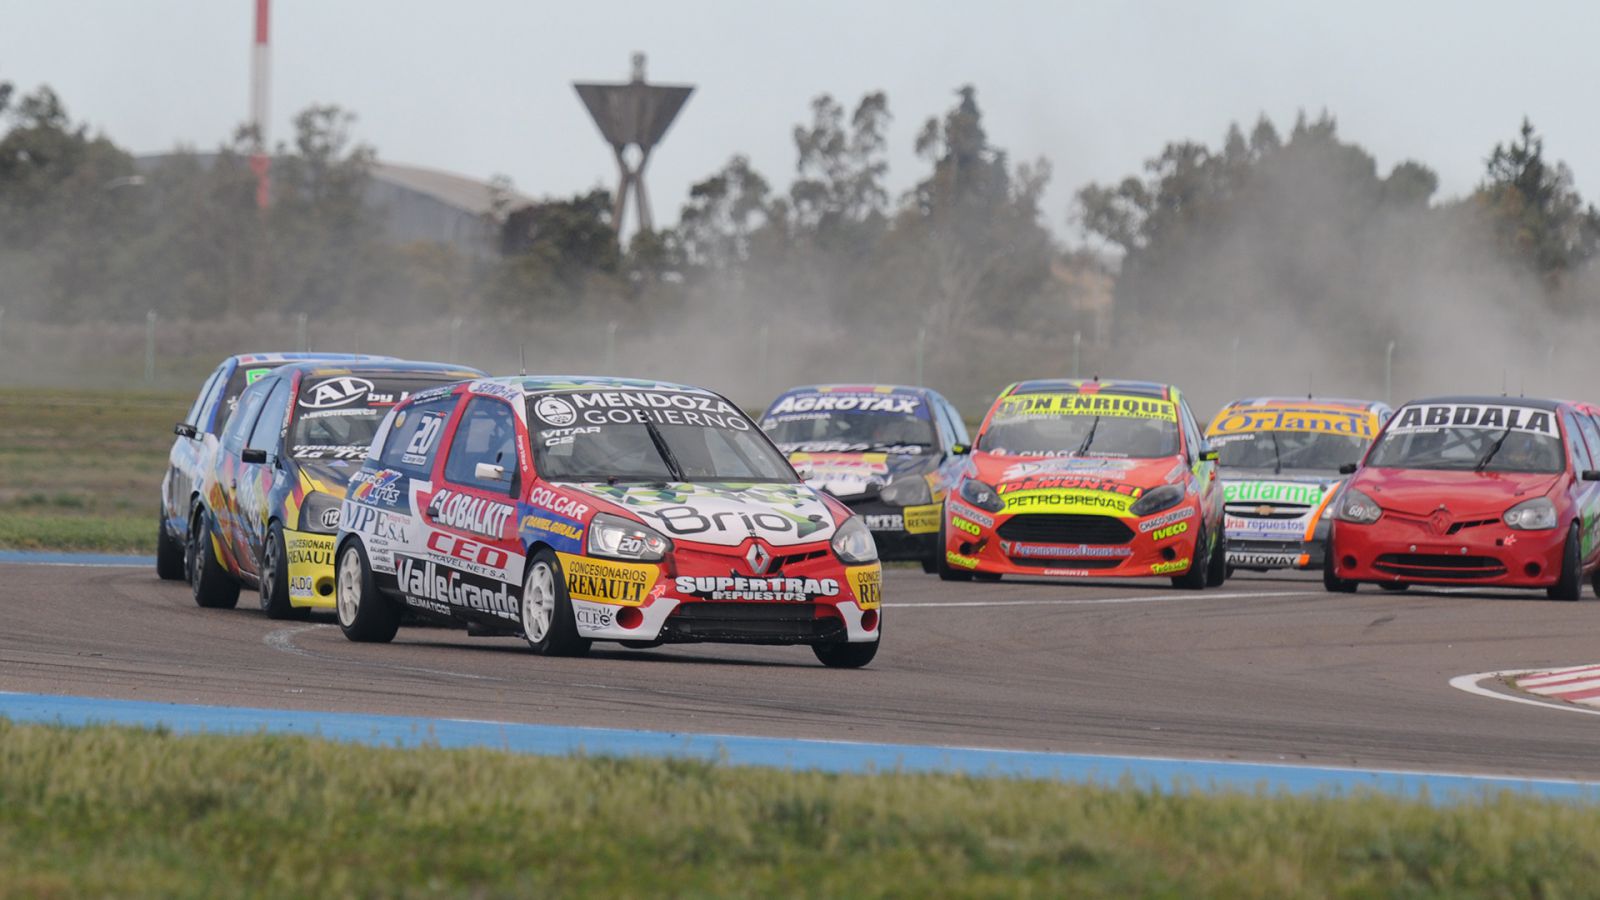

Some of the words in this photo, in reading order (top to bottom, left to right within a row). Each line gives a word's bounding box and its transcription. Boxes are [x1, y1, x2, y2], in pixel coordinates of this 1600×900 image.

[313, 378, 368, 405] AL
[367, 392, 394, 404] by
[572, 393, 741, 416] MENDOZA
[771, 397, 920, 414] AGROTAX
[1060, 398, 1175, 415] ENRIQUE
[584, 409, 750, 431] GOBIERNO
[1217, 413, 1372, 436] Orlandi
[1400, 407, 1550, 433] ABDALA
[406, 416, 442, 455] 20
[541, 426, 601, 439] VITAR
[545, 435, 575, 447] C2
[1006, 478, 1134, 496] DEMONTE
[430, 489, 514, 538] GLOBALKIT
[531, 487, 589, 520] COLCAR
[1008, 495, 1061, 509] PETRO
[1064, 496, 1127, 512] BRENAS
[324, 511, 340, 525] 112
[655, 505, 793, 535] Brio
[865, 514, 904, 529] MTR
[952, 516, 980, 536] IVECO
[1247, 518, 1305, 531] repuestos
[1153, 522, 1187, 540] IVECO
[427, 531, 509, 570] CEO
[620, 538, 641, 552] 20
[428, 552, 463, 569] TRAVEL
[466, 562, 488, 575] NET
[1227, 554, 1296, 566] AUTOWAY
[569, 561, 647, 582] CONCESIONARIOS
[568, 573, 646, 602] RENAULT
[675, 576, 840, 597] SUPERTRAC
[712, 591, 808, 602] REPUESTOS
